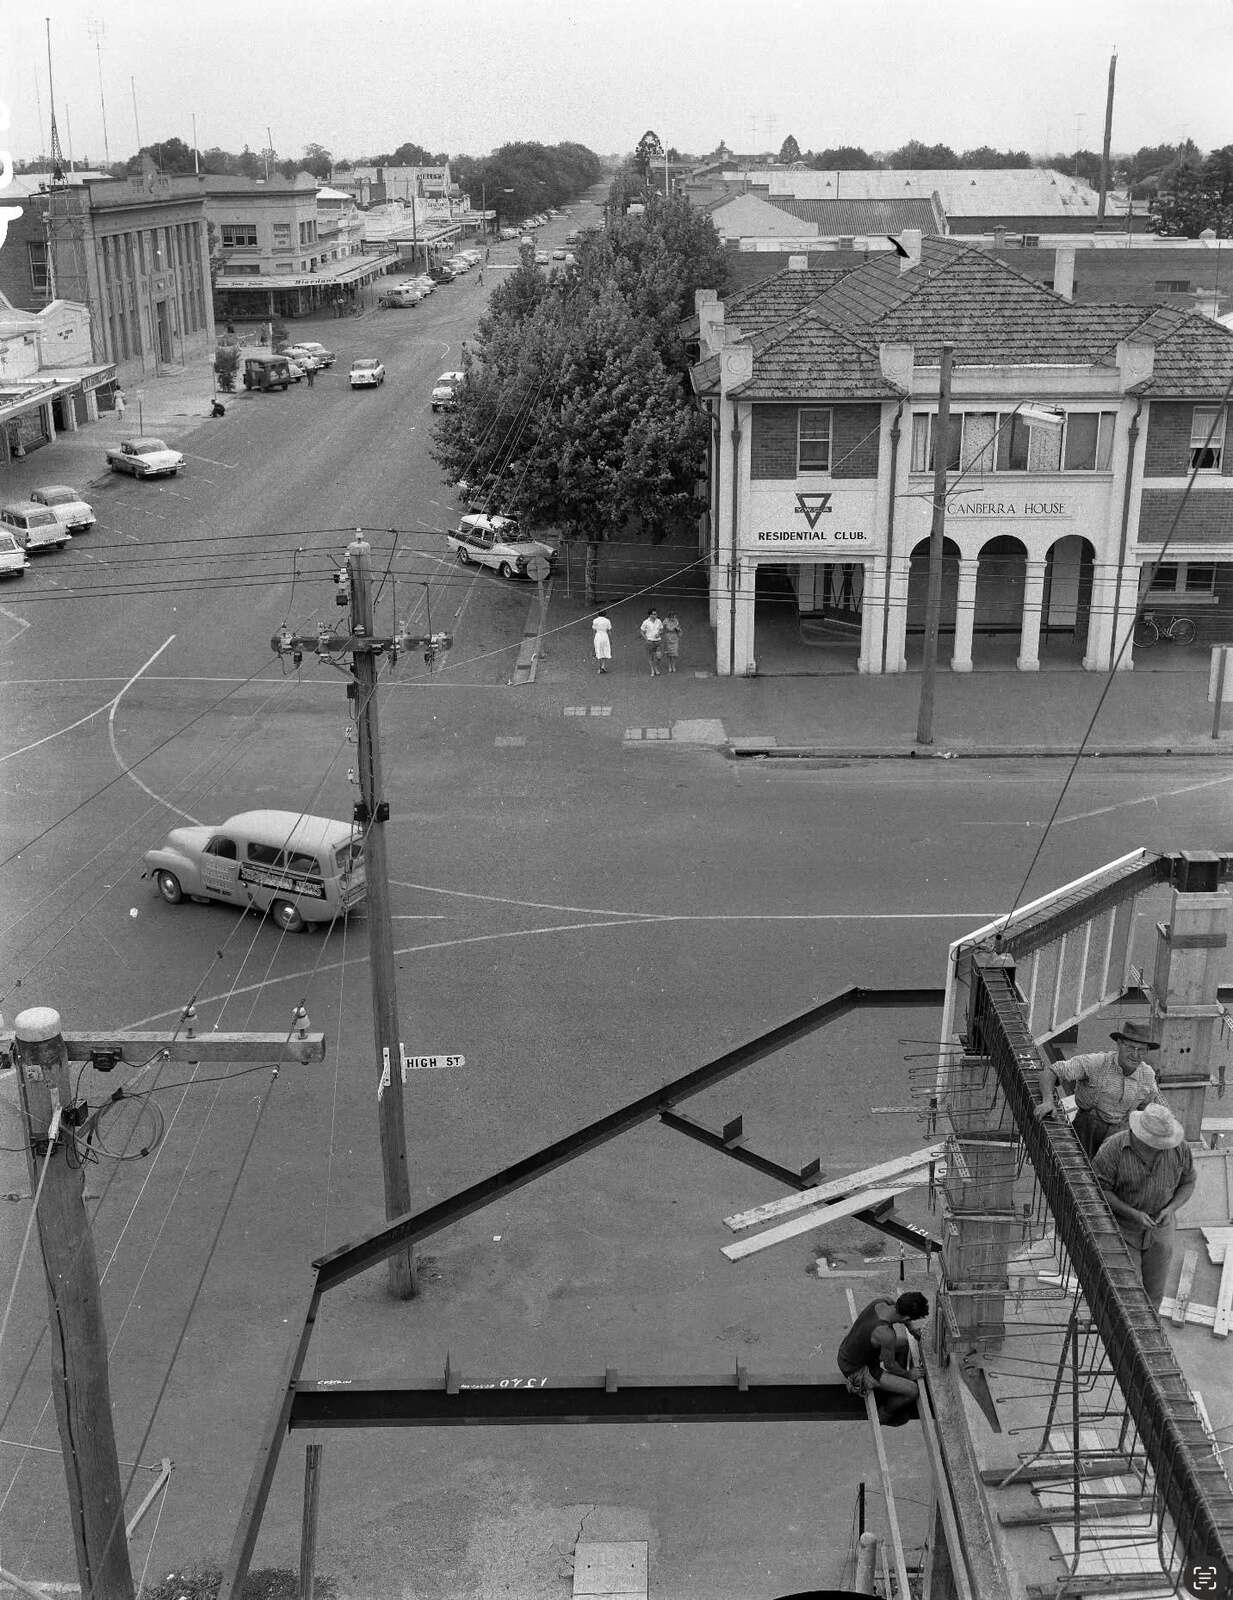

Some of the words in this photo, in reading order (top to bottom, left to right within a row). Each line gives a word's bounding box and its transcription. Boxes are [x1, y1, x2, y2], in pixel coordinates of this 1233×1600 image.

[947, 503, 1016, 514] CANBERRA
[1024, 502, 1066, 514] HOUSE
[758, 531, 828, 541] RESIDENTIAL
[834, 531, 867, 540] CLUB.
[407, 1058, 437, 1068] HIGH
[446, 1057, 460, 1066] ST
